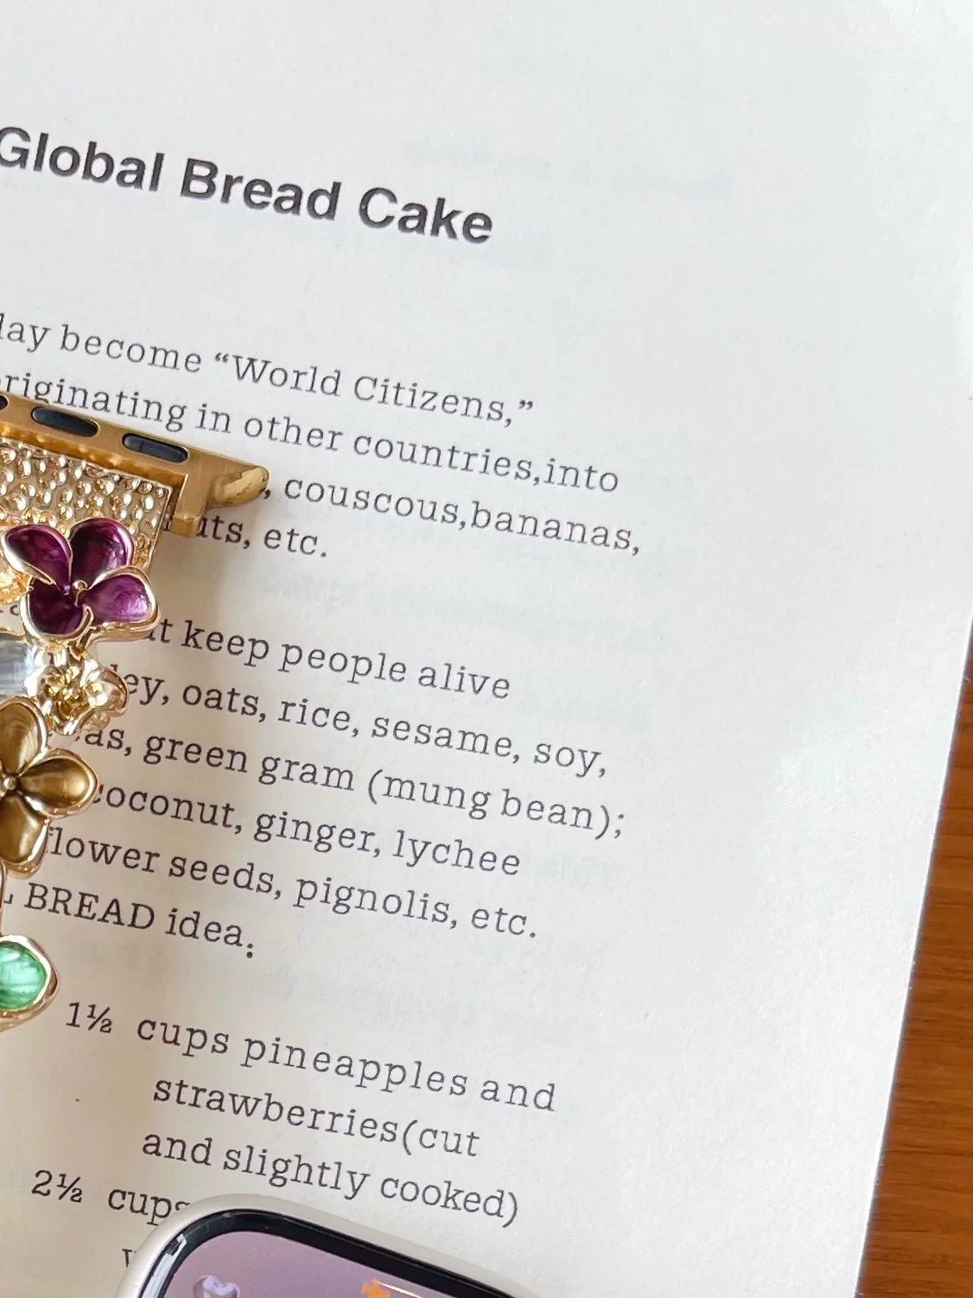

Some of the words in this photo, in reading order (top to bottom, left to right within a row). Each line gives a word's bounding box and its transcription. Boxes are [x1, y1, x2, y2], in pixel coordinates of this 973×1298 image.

[179, 157, 343, 222] Bread
[358, 186, 493, 245] Cake
[59, 323, 202, 374] become
[195, 402, 232, 434] in
[243, 415, 344, 452] other
[263, 528, 327, 558] etc.
[180, 619, 270, 668] keep
[277, 643, 407, 685] people
[417, 662, 510, 700] alive
[182, 684, 267, 724] oats,
[277, 697, 360, 738] rice,
[371, 716, 520, 765] sesame,
[533, 742, 606, 779] soy,
[142, 735, 248, 774] green
[257, 756, 355, 792] gram
[367, 768, 492, 821] (mung
[500, 788, 624, 841] bean);
[253, 810, 381, 859] ginger,
[391, 829, 521, 876] lychee
[23, 881, 155, 930] BREAD
[168, 855, 282, 901] seeds,
[292, 876, 458, 930] pignolis,
[470, 907, 536, 939] etc.
[136, 1018, 230, 1058] cups
[239, 1036, 468, 1096] pineapples
[479, 1079, 556, 1112] and
[141, 1133, 213, 1167] and
[222, 1144, 372, 1201] slightly
[380, 1177, 519, 1229] cooked)
